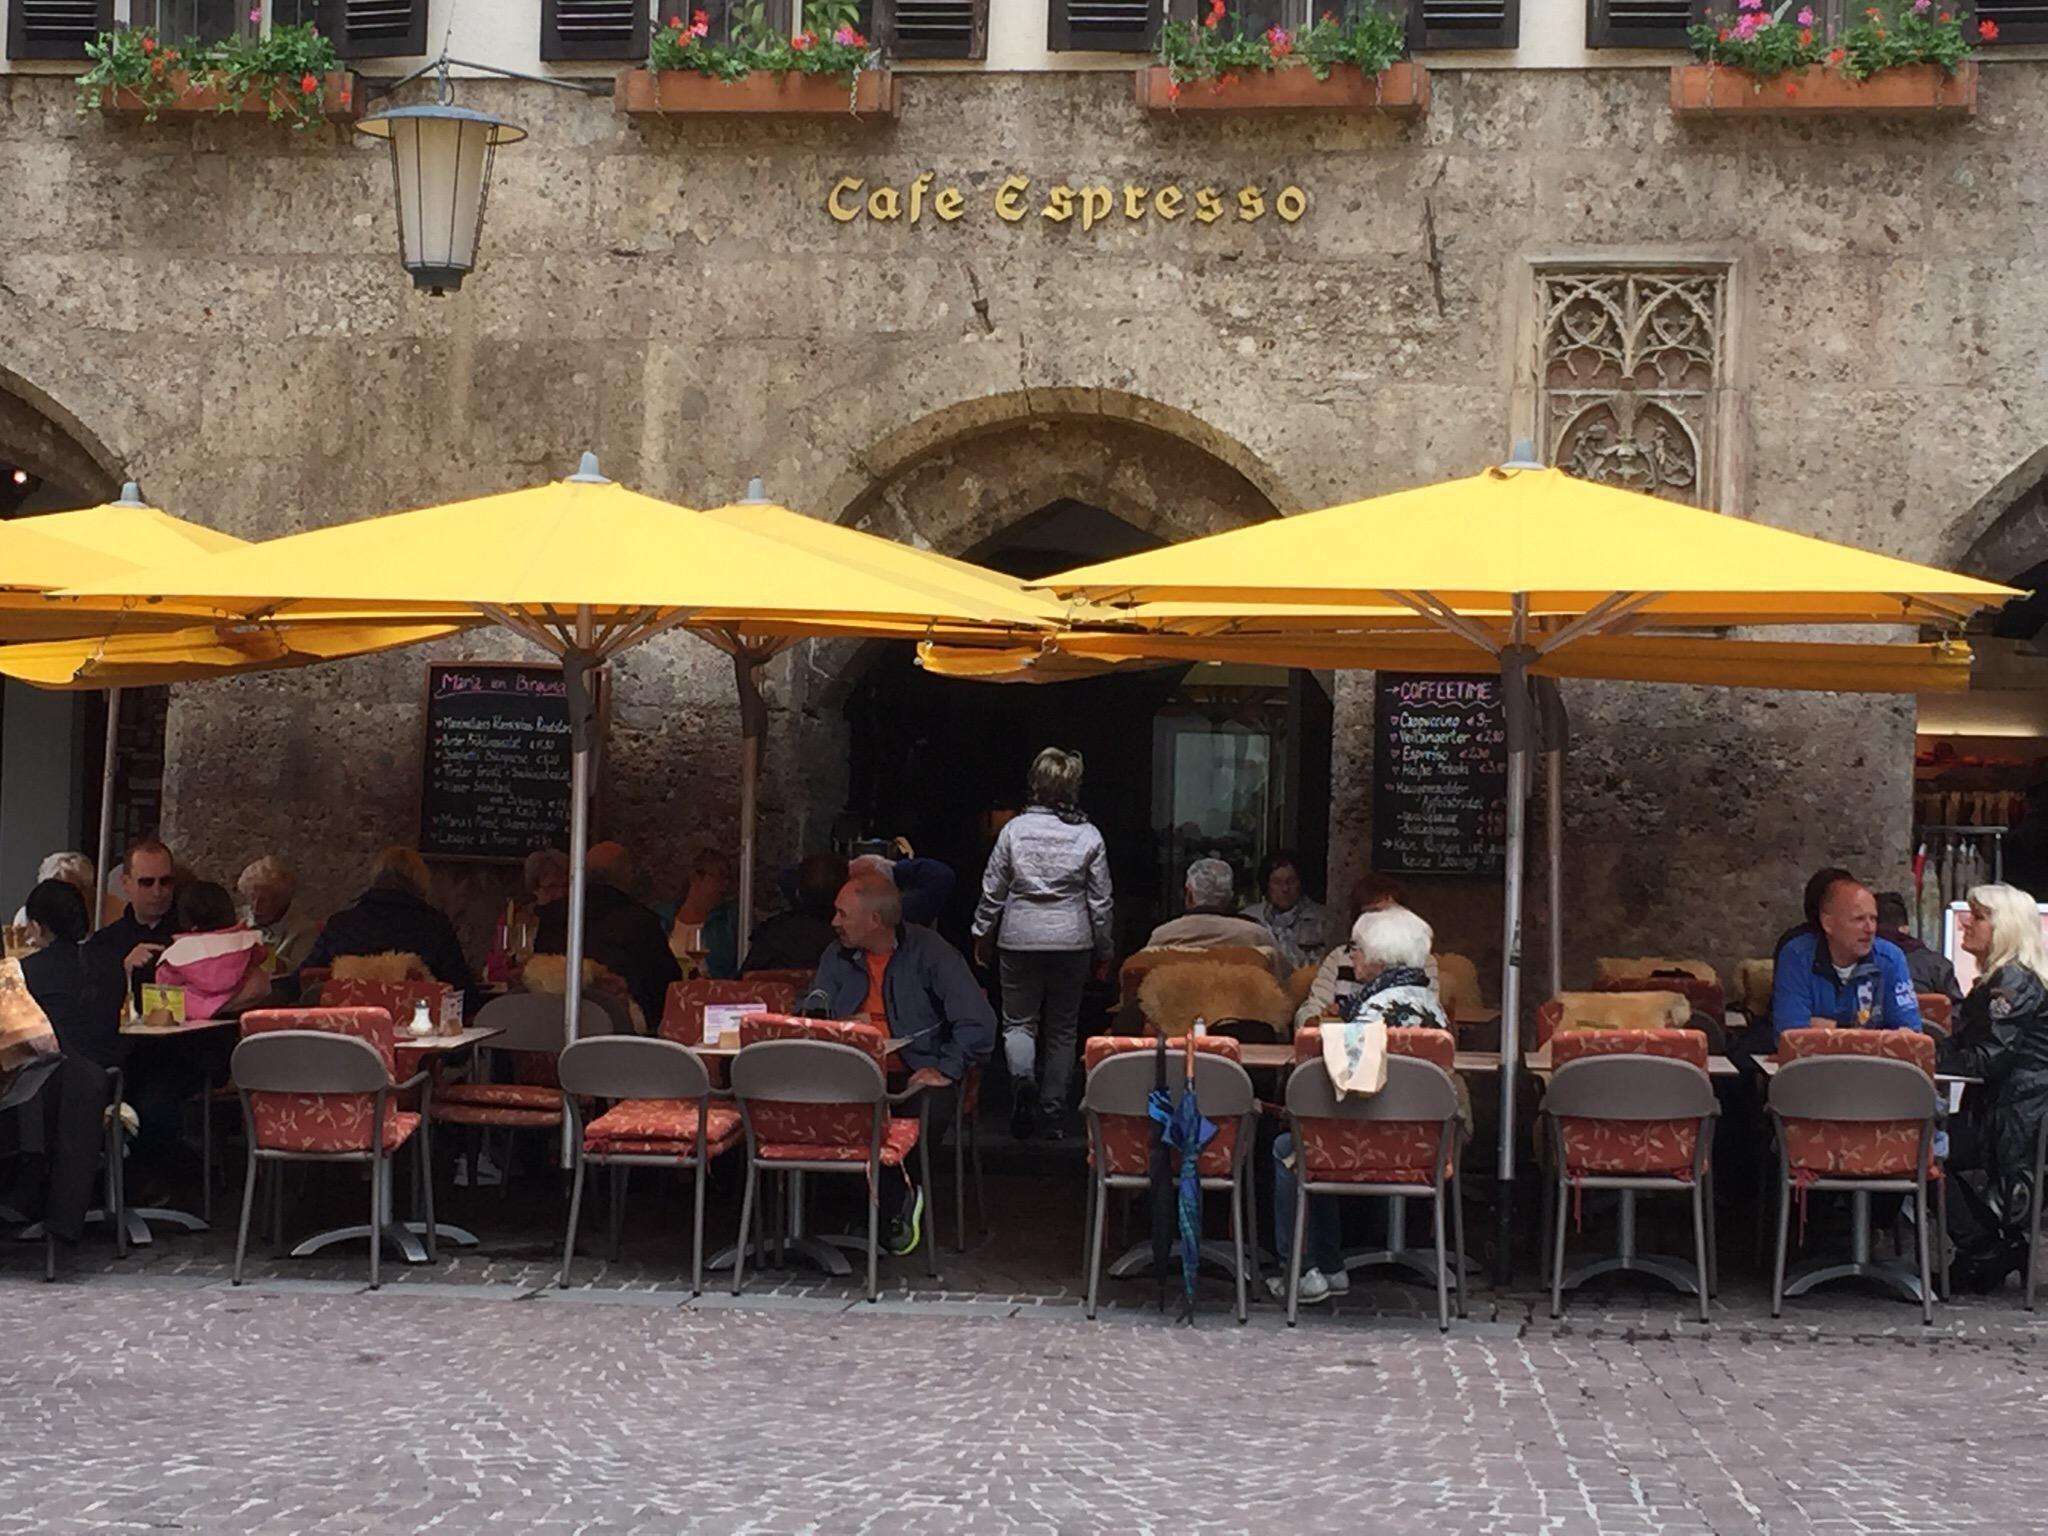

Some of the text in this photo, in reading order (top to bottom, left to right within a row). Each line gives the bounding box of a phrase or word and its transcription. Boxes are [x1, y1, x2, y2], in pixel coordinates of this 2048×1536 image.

[828, 172, 1308, 232] Cafe Espresso
[1400, 680, 1493, 700] COFFEETIME
[1400, 710, 1461, 732] Cappuccino
